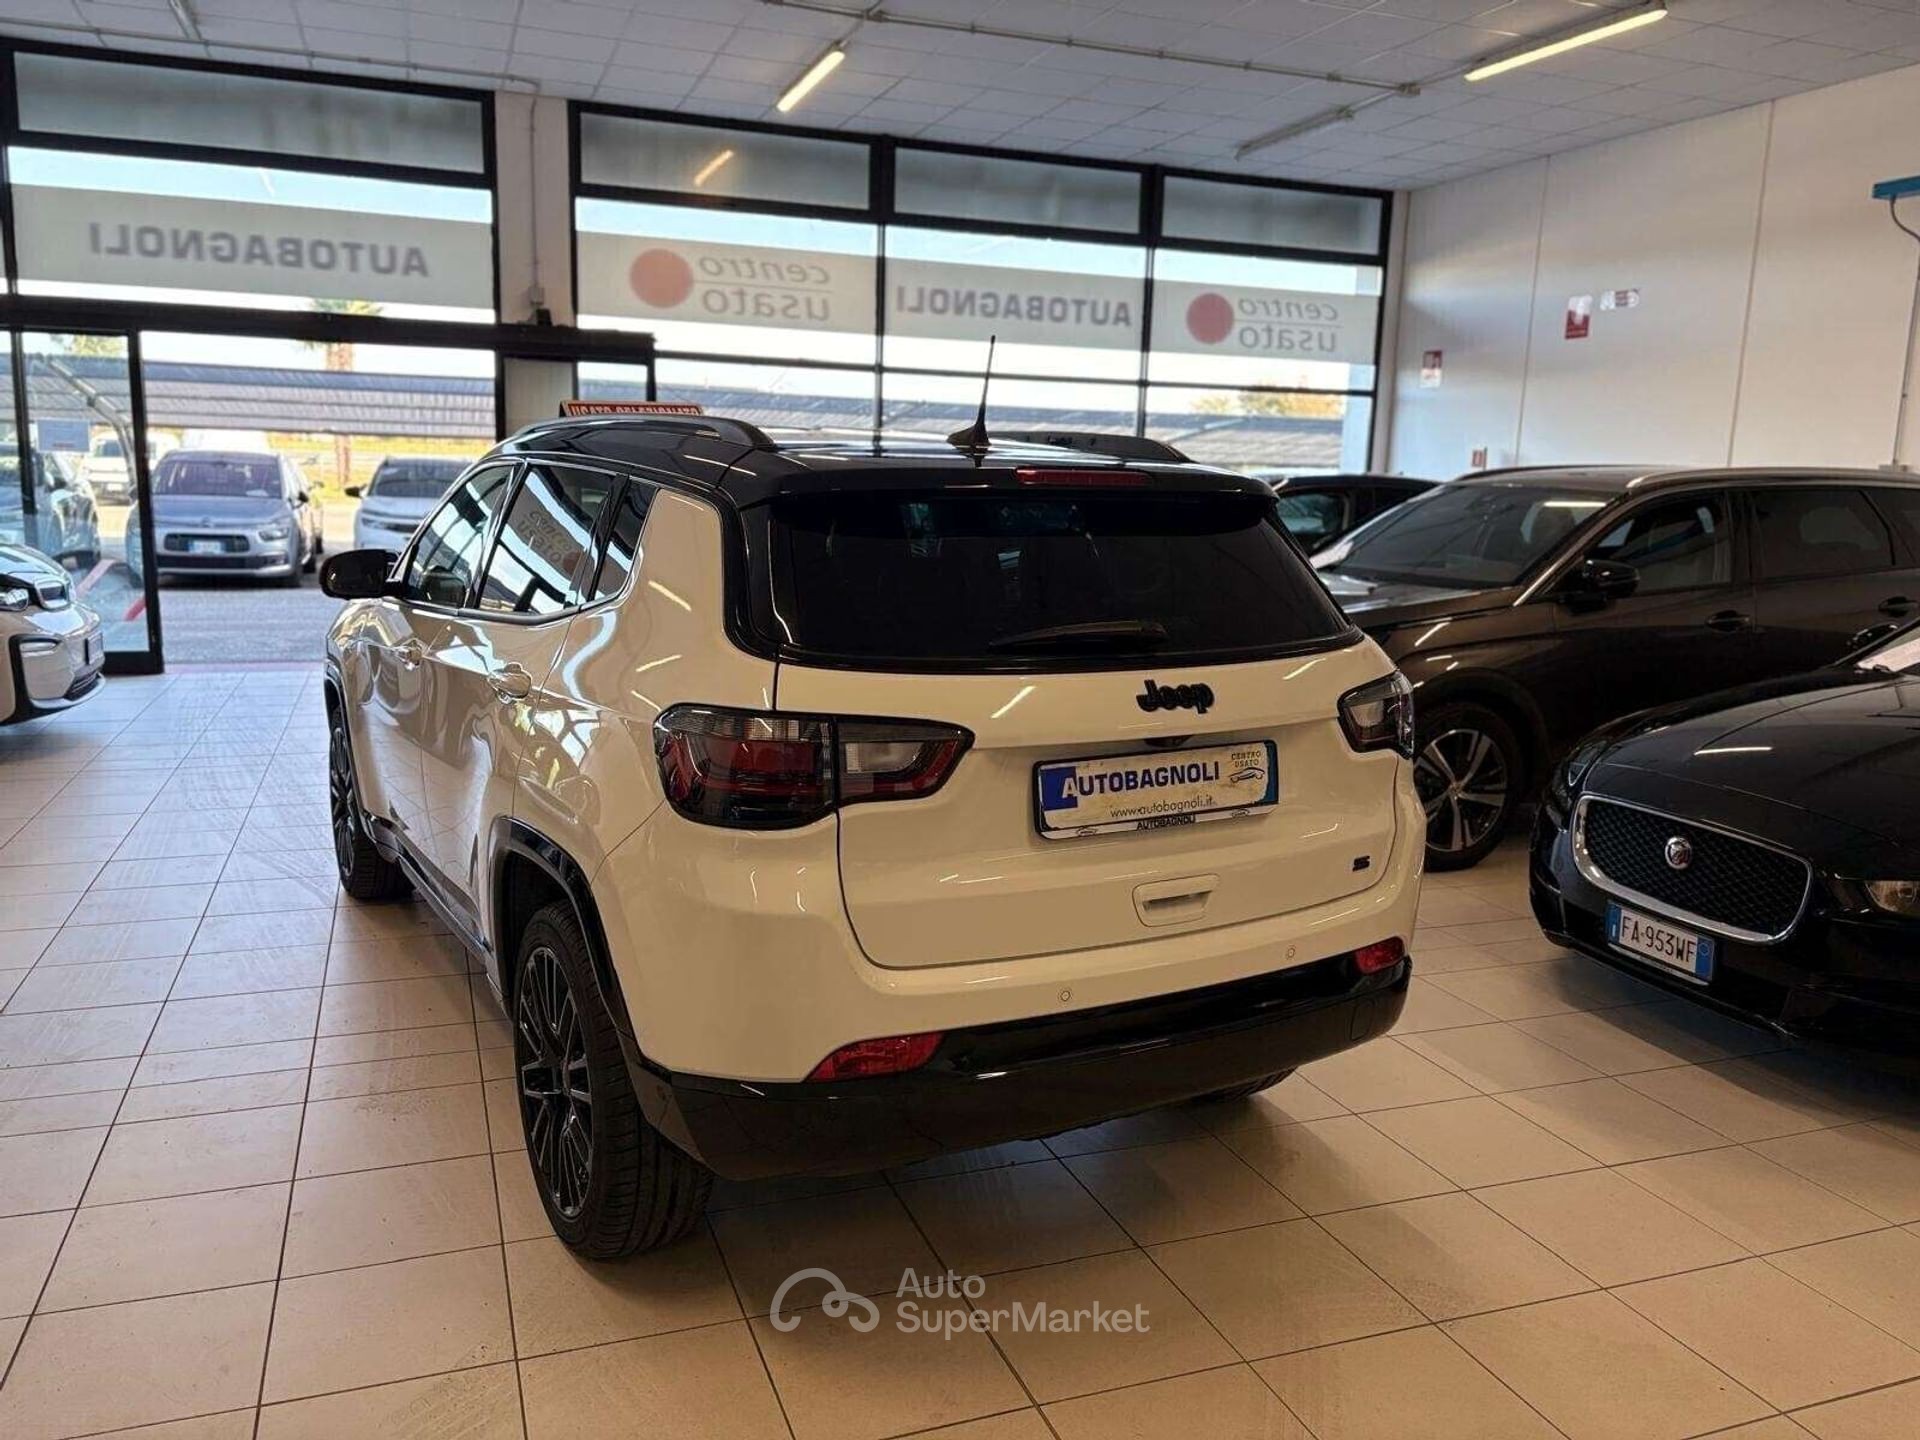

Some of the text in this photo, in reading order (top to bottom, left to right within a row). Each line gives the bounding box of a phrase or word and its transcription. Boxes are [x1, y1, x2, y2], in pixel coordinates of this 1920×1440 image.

[1136, 679, 1215, 714] Jeep
[1231, 750, 1261, 761] CENTRO
[1234, 759, 1259, 769] USATO
[1061, 761, 1220, 799] AUTOBAGNOLI
[1110, 793, 1214, 818] www.autobagnoli.it
[1136, 814, 1196, 831] AUTOBAGNOLI
